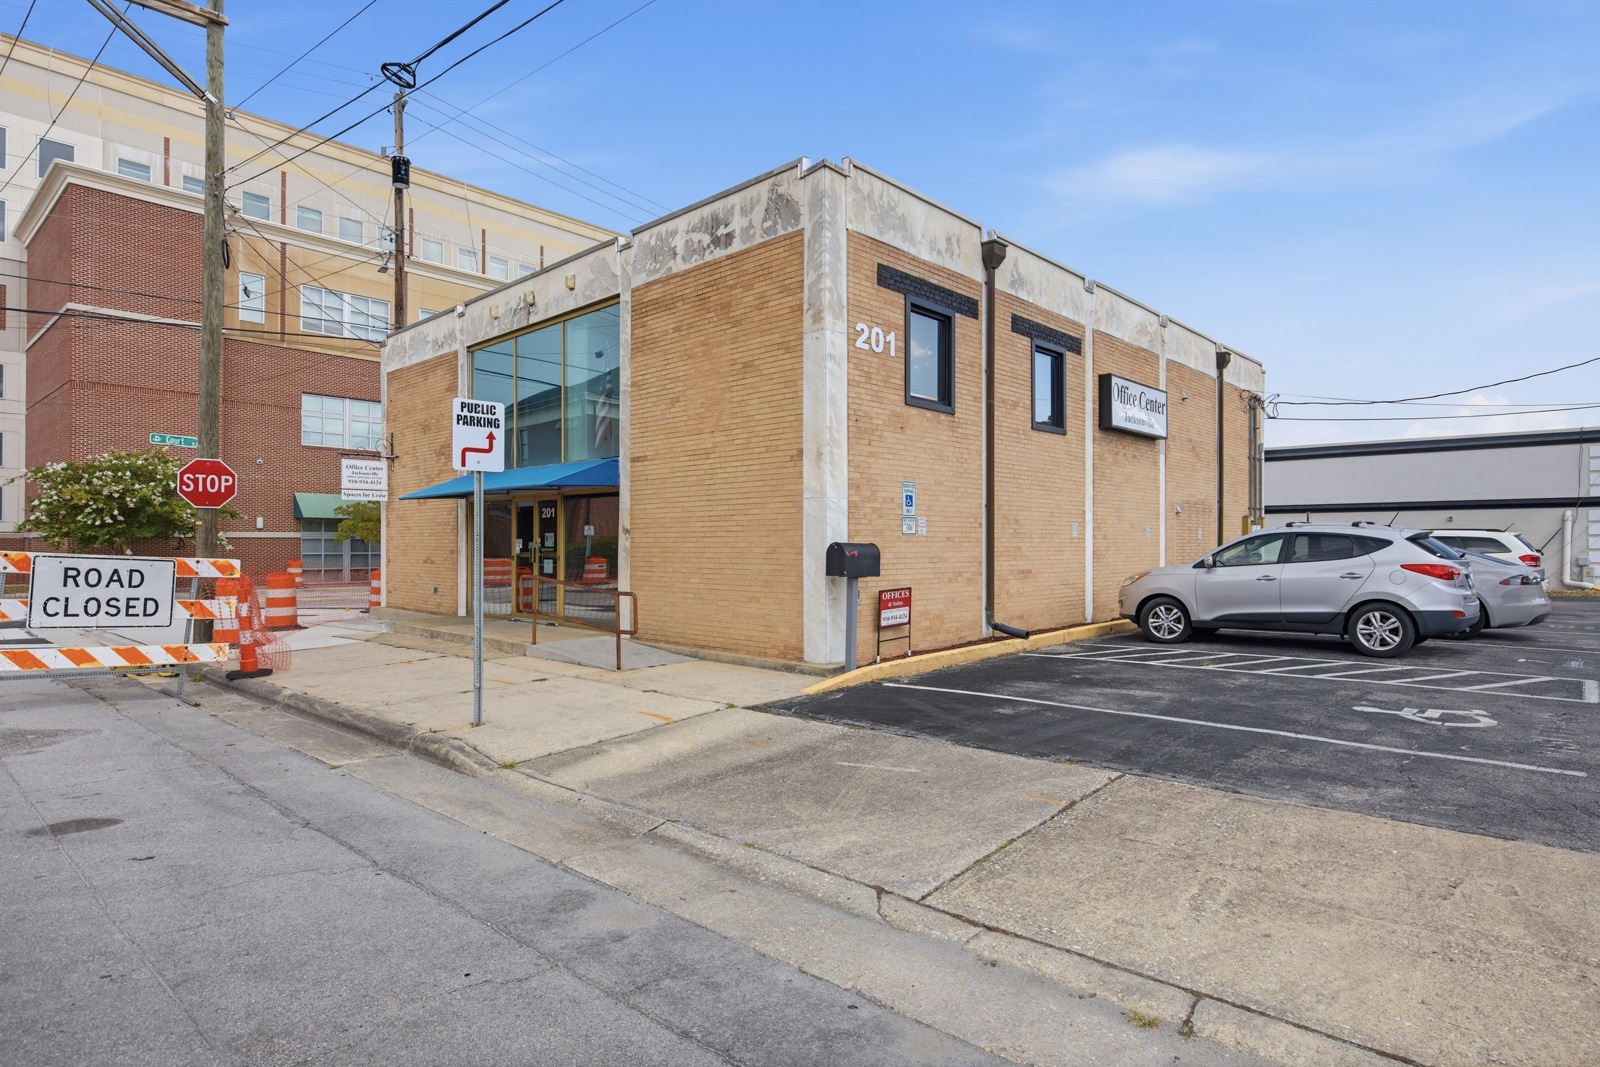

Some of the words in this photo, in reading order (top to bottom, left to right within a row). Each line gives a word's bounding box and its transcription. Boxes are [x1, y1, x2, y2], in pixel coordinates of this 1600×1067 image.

[855, 322, 896, 357] 201
[1112, 382, 1138, 408] Office
[1139, 391, 1166, 415] Center
[460, 401, 497, 416] PUBLIC
[456, 413, 501, 429] PARKING
[165, 435, 184, 445] Court
[181, 473, 233, 493] STOP
[541, 507, 555, 518] 201
[62, 566, 145, 589] ROAD
[882, 590, 910, 600] OFFICES
[42, 596, 159, 617] CLOSED
